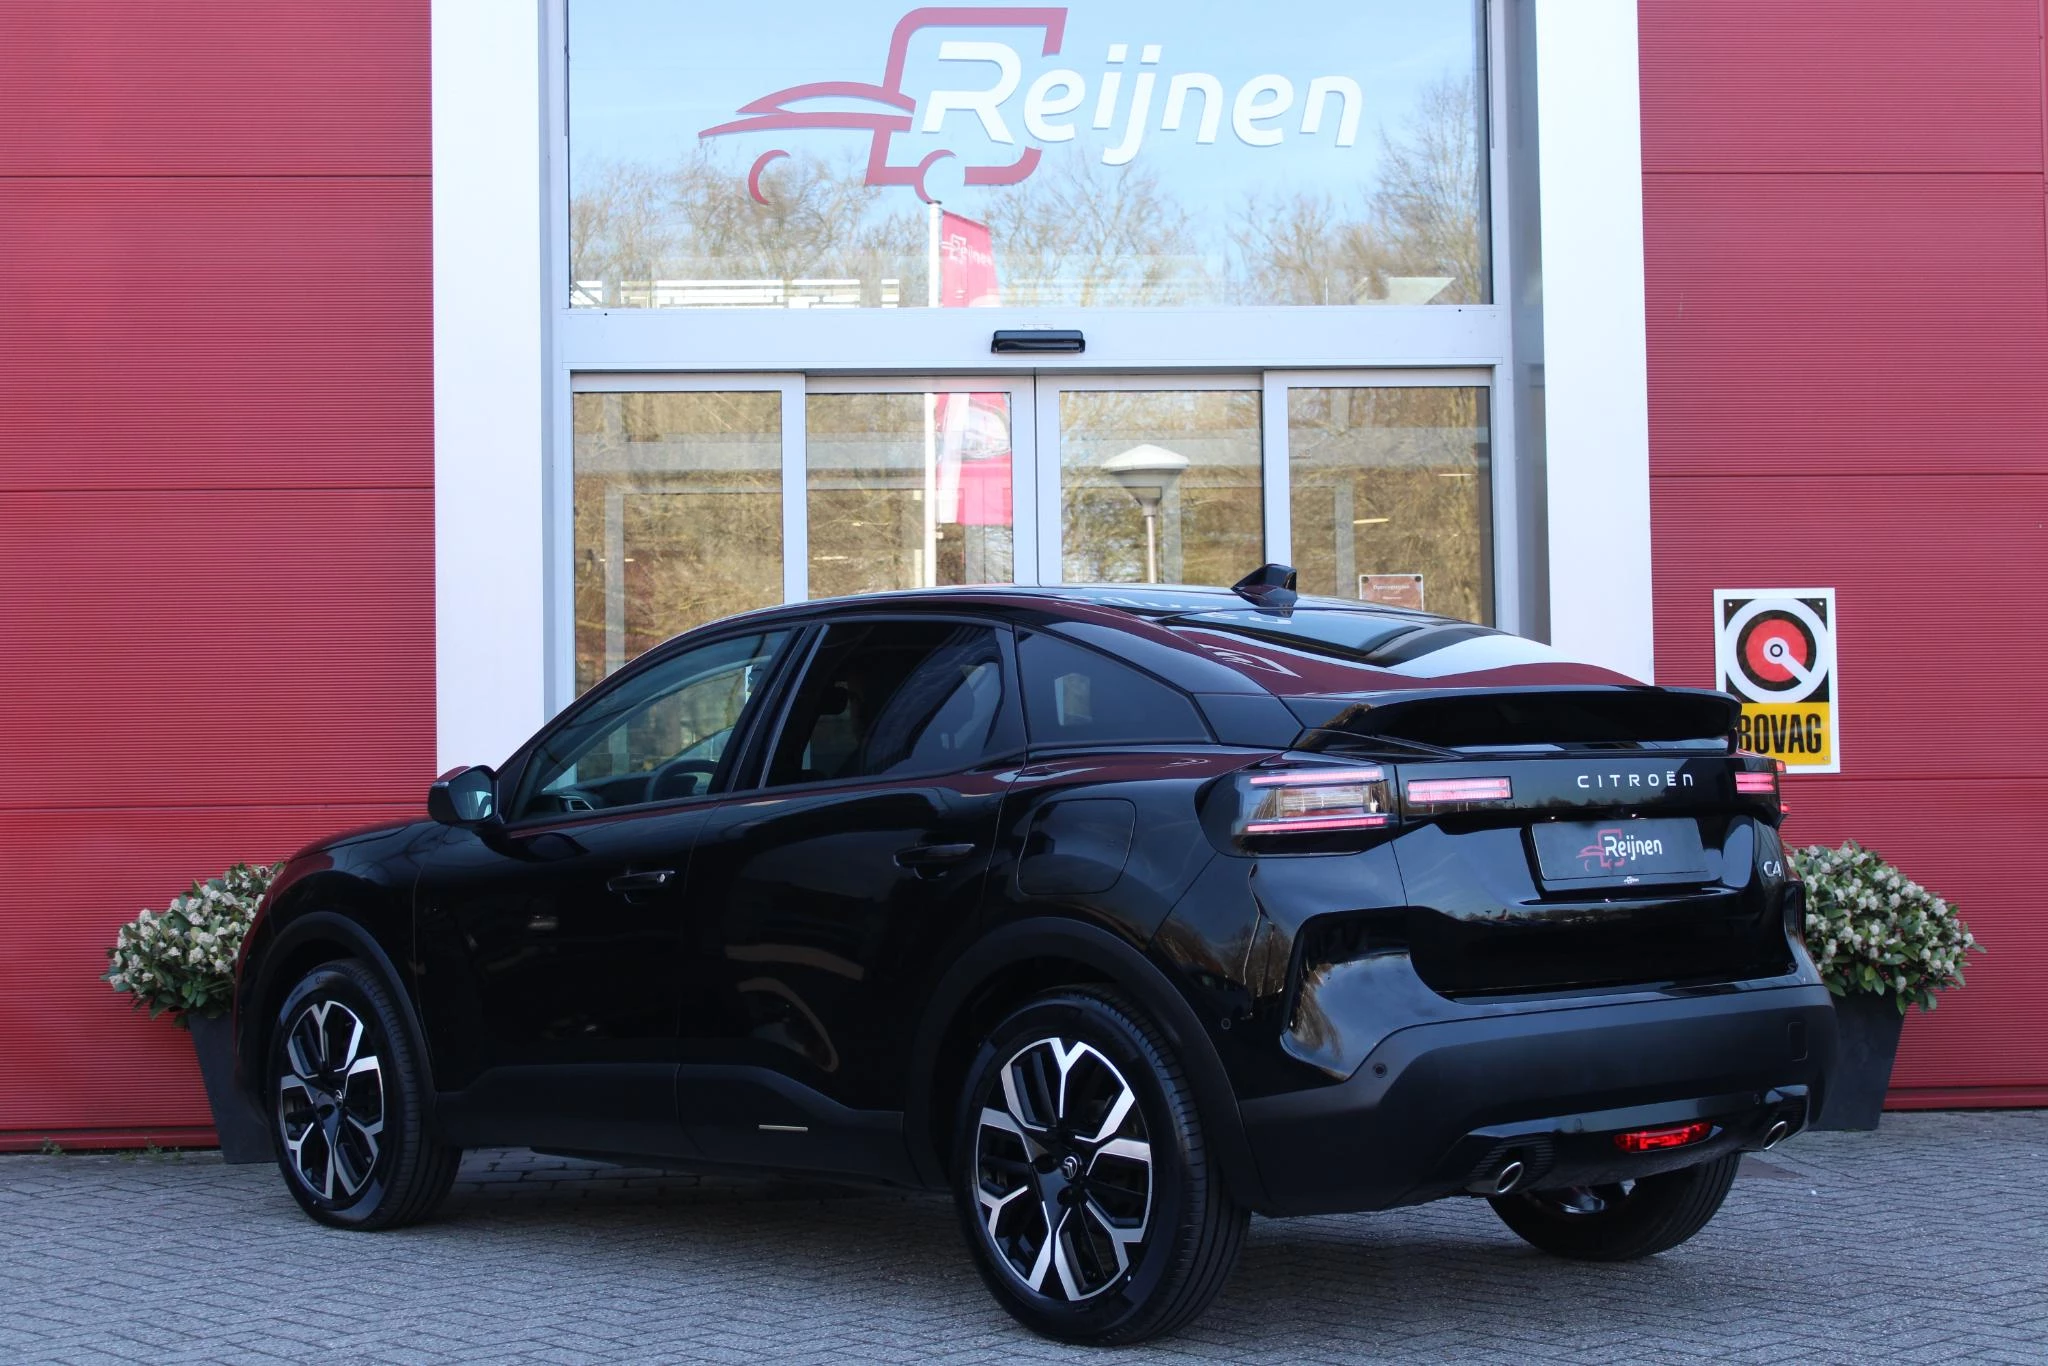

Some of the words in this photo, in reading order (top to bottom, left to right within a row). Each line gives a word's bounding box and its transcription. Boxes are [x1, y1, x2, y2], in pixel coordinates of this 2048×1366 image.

[921, 41, 1363, 166] Reijnen
[1739, 713, 1822, 754] BOVAG
[1603, 834, 1663, 861] Reijnen
[1763, 860, 1782, 877] C4
